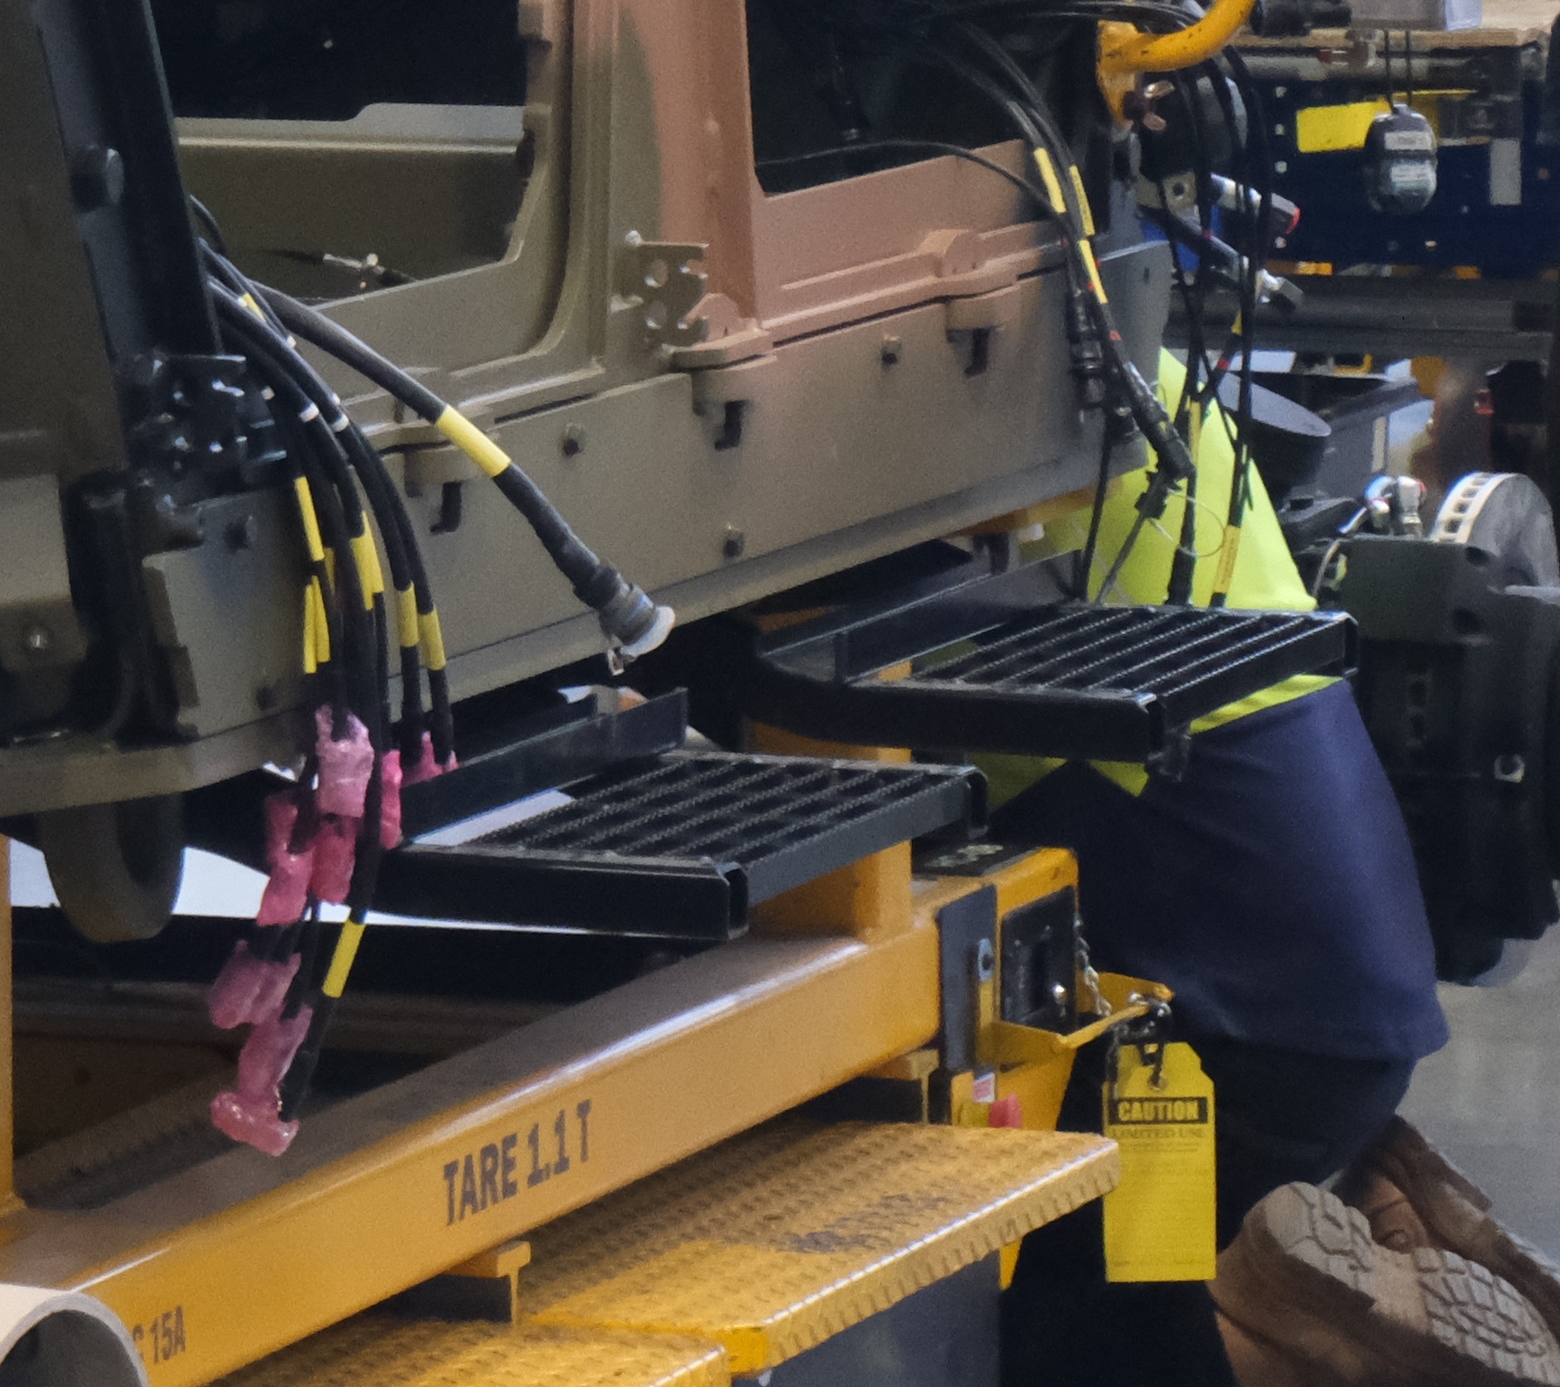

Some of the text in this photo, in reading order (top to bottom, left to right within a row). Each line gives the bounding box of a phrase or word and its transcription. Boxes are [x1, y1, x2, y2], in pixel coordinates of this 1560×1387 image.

[1118, 1100, 1199, 1121] CAUTION
[443, 1098, 592, 1226] TARE 1.1 T
[150, 1304, 186, 1365] 15A
